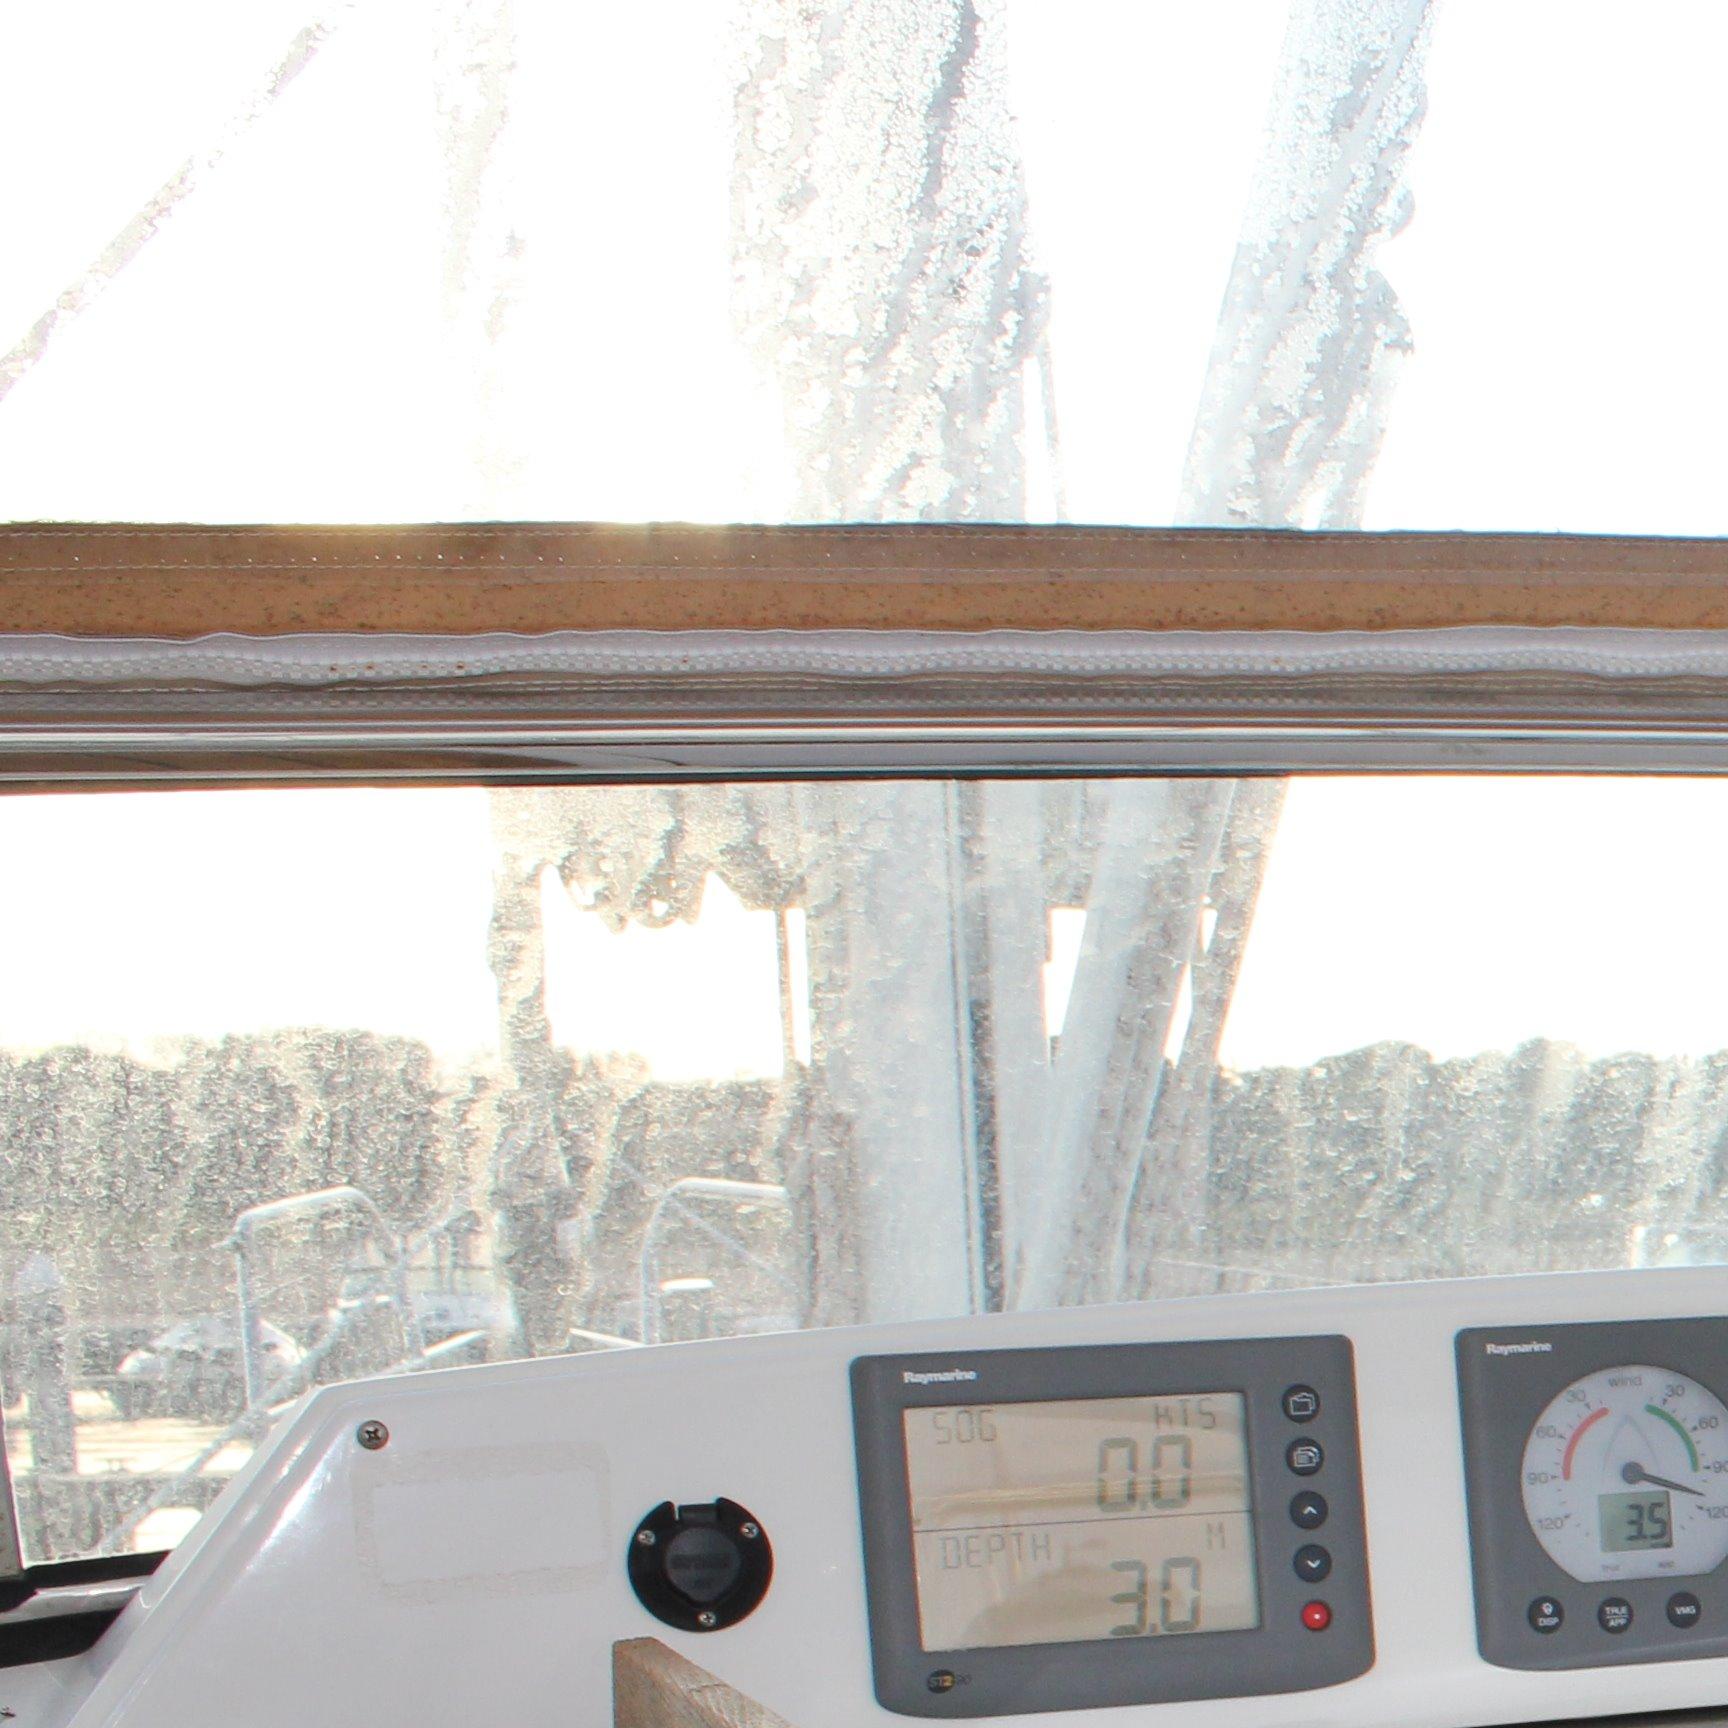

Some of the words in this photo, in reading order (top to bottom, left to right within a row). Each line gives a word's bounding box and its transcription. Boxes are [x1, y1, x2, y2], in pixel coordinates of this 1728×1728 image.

[1485, 1340, 1552, 1356] Raymarine
[903, 1368, 977, 1385] Raymarine
[1664, 1384, 1686, 1398] 30
[933, 1409, 998, 1445] SOG
[1700, 1415, 1720, 1430] 60
[1536, 1426, 1558, 1440] 60
[1526, 1471, 1549, 1486] 90
[1538, 1517, 1564, 1531] 120
[1206, 1522, 1226, 1550] M
[941, 1532, 1053, 1571] DEPTH
[1108, 1556, 1201, 1637] 3.0
[1675, 1605, 1697, 1615] VMG
